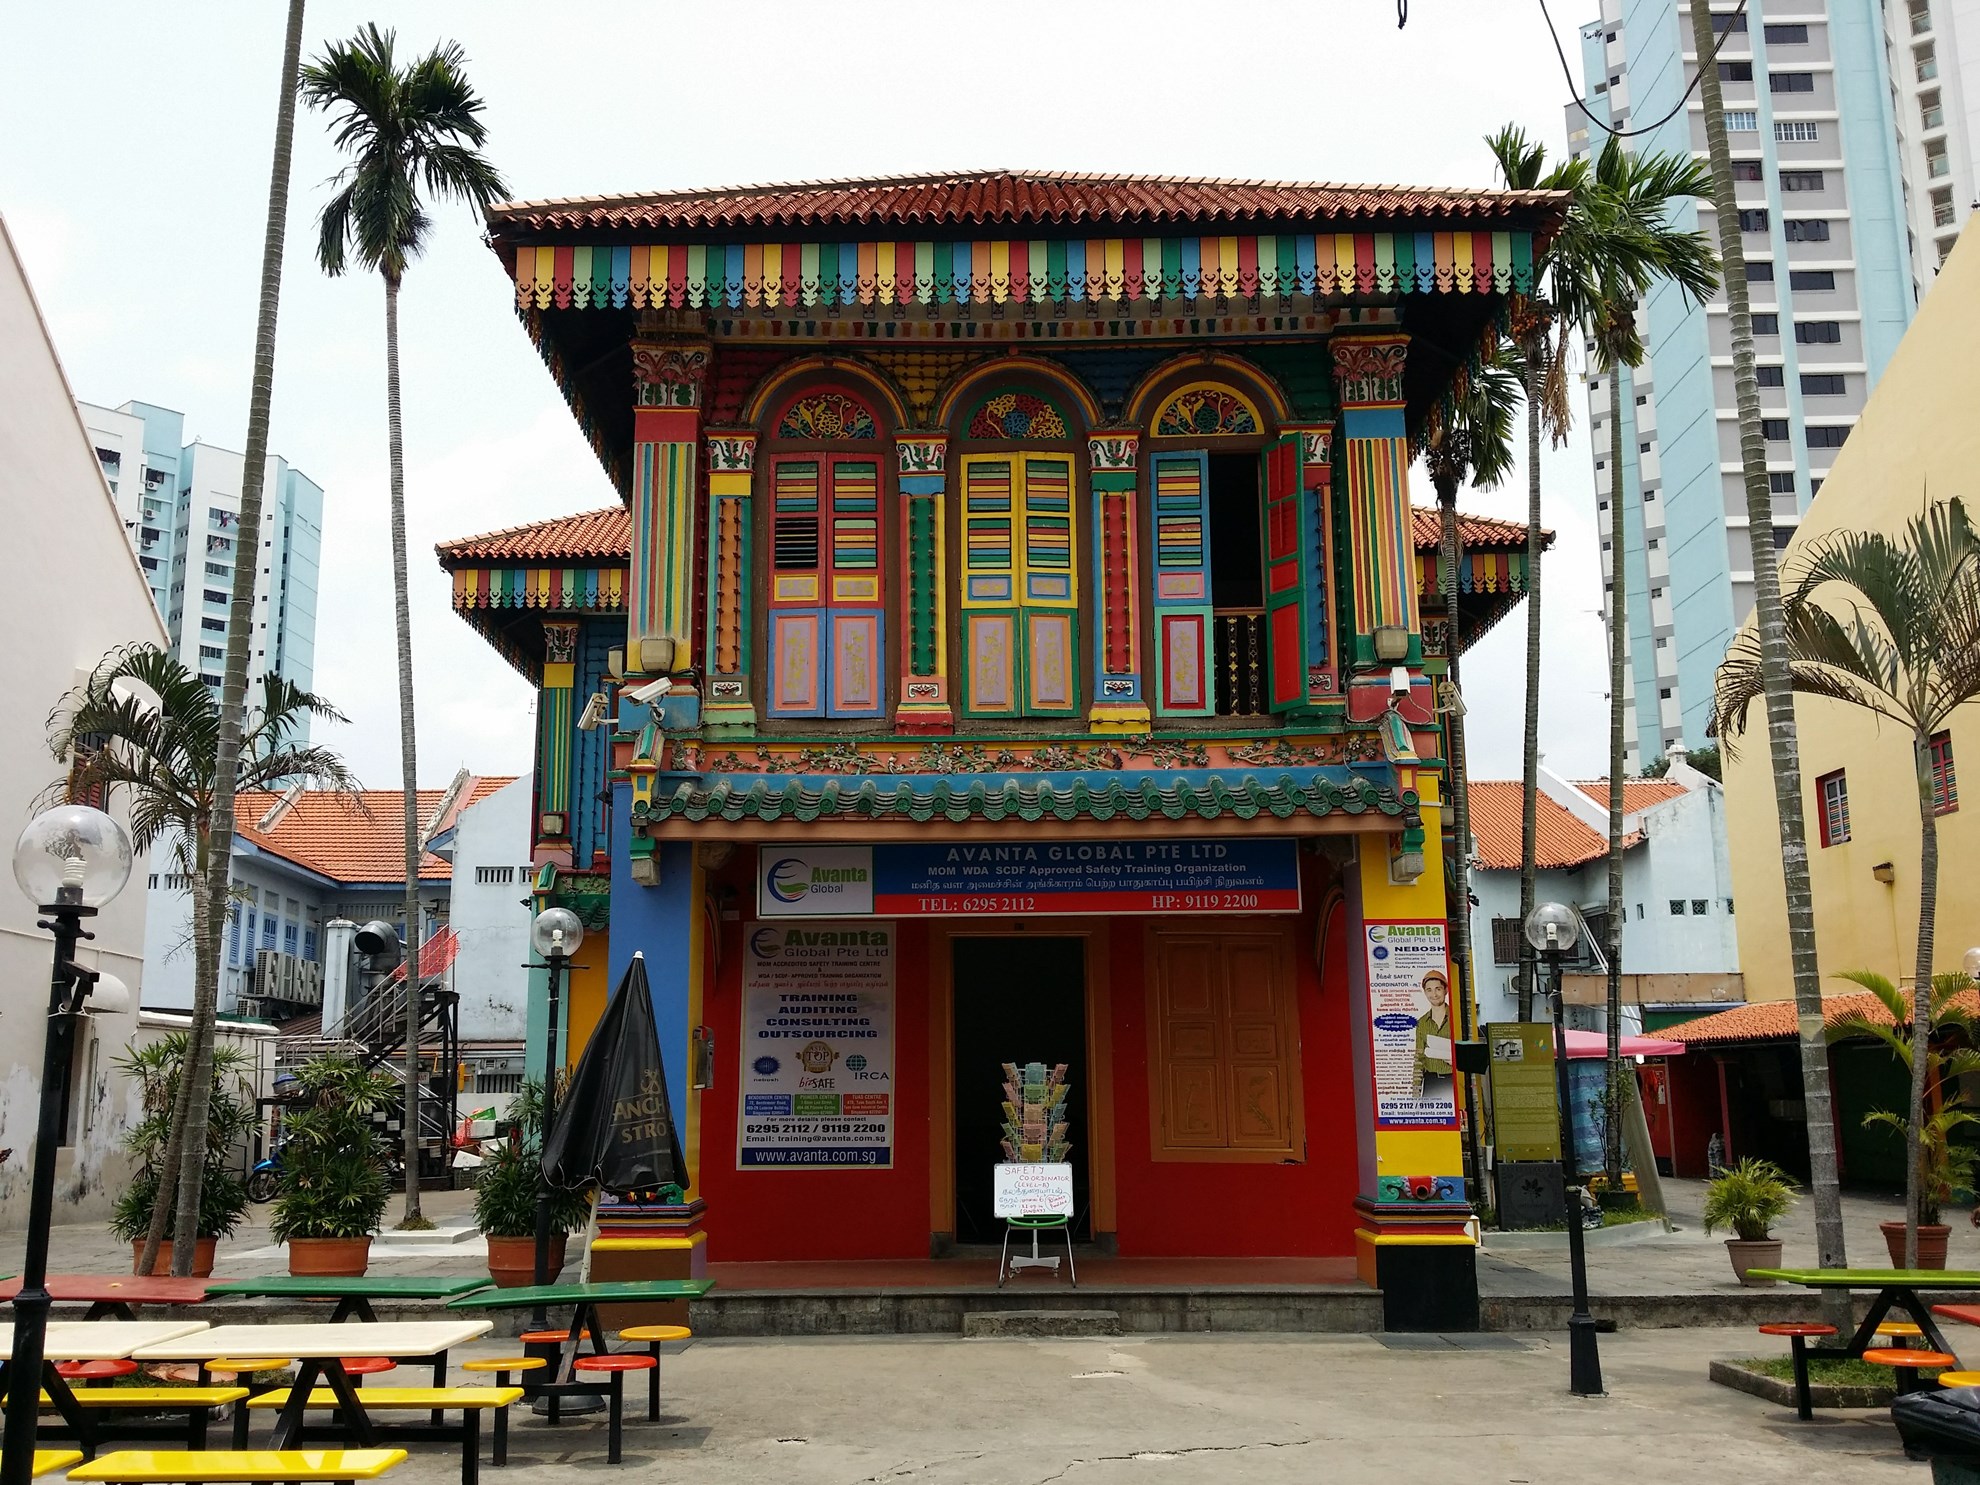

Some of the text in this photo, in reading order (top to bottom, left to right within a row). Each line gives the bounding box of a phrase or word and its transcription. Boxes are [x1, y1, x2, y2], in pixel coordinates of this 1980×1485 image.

[947, 844, 1228, 862] AVANTA GLOBAL PTE LTD
[811, 867, 867, 882] Avanta
[928, 863, 1247, 877] MOM WDA SCDF Approved Safety Training Organization
[811, 884, 843, 893] Global
[918, 897, 1035, 911] TEL: 6295 2112
[1152, 894, 1258, 909] HP: 9119 2200
[1388, 926, 1441, 936] Avanta
[785, 929, 888, 946] Avanta
[784, 948, 889, 957] Global Pte Ltd
[778, 994, 858, 1002] TRAINING
[778, 1006, 858, 1014] AUDITING
[766, 1018, 870, 1026] CONSULTING
[758, 1030, 878, 1038] OUTSOURCING
[807, 1051, 830, 1061] TOP
[854, 1072, 889, 1080] IRCA
[746, 1124, 886, 1133] 6295 2112 / 9119 2200
[778, 1135, 886, 1143] training@avanta.com.sg
[755, 1149, 877, 1164] www.avanta.com.sg
[1005, 1166, 1044, 1175] SAFETY
